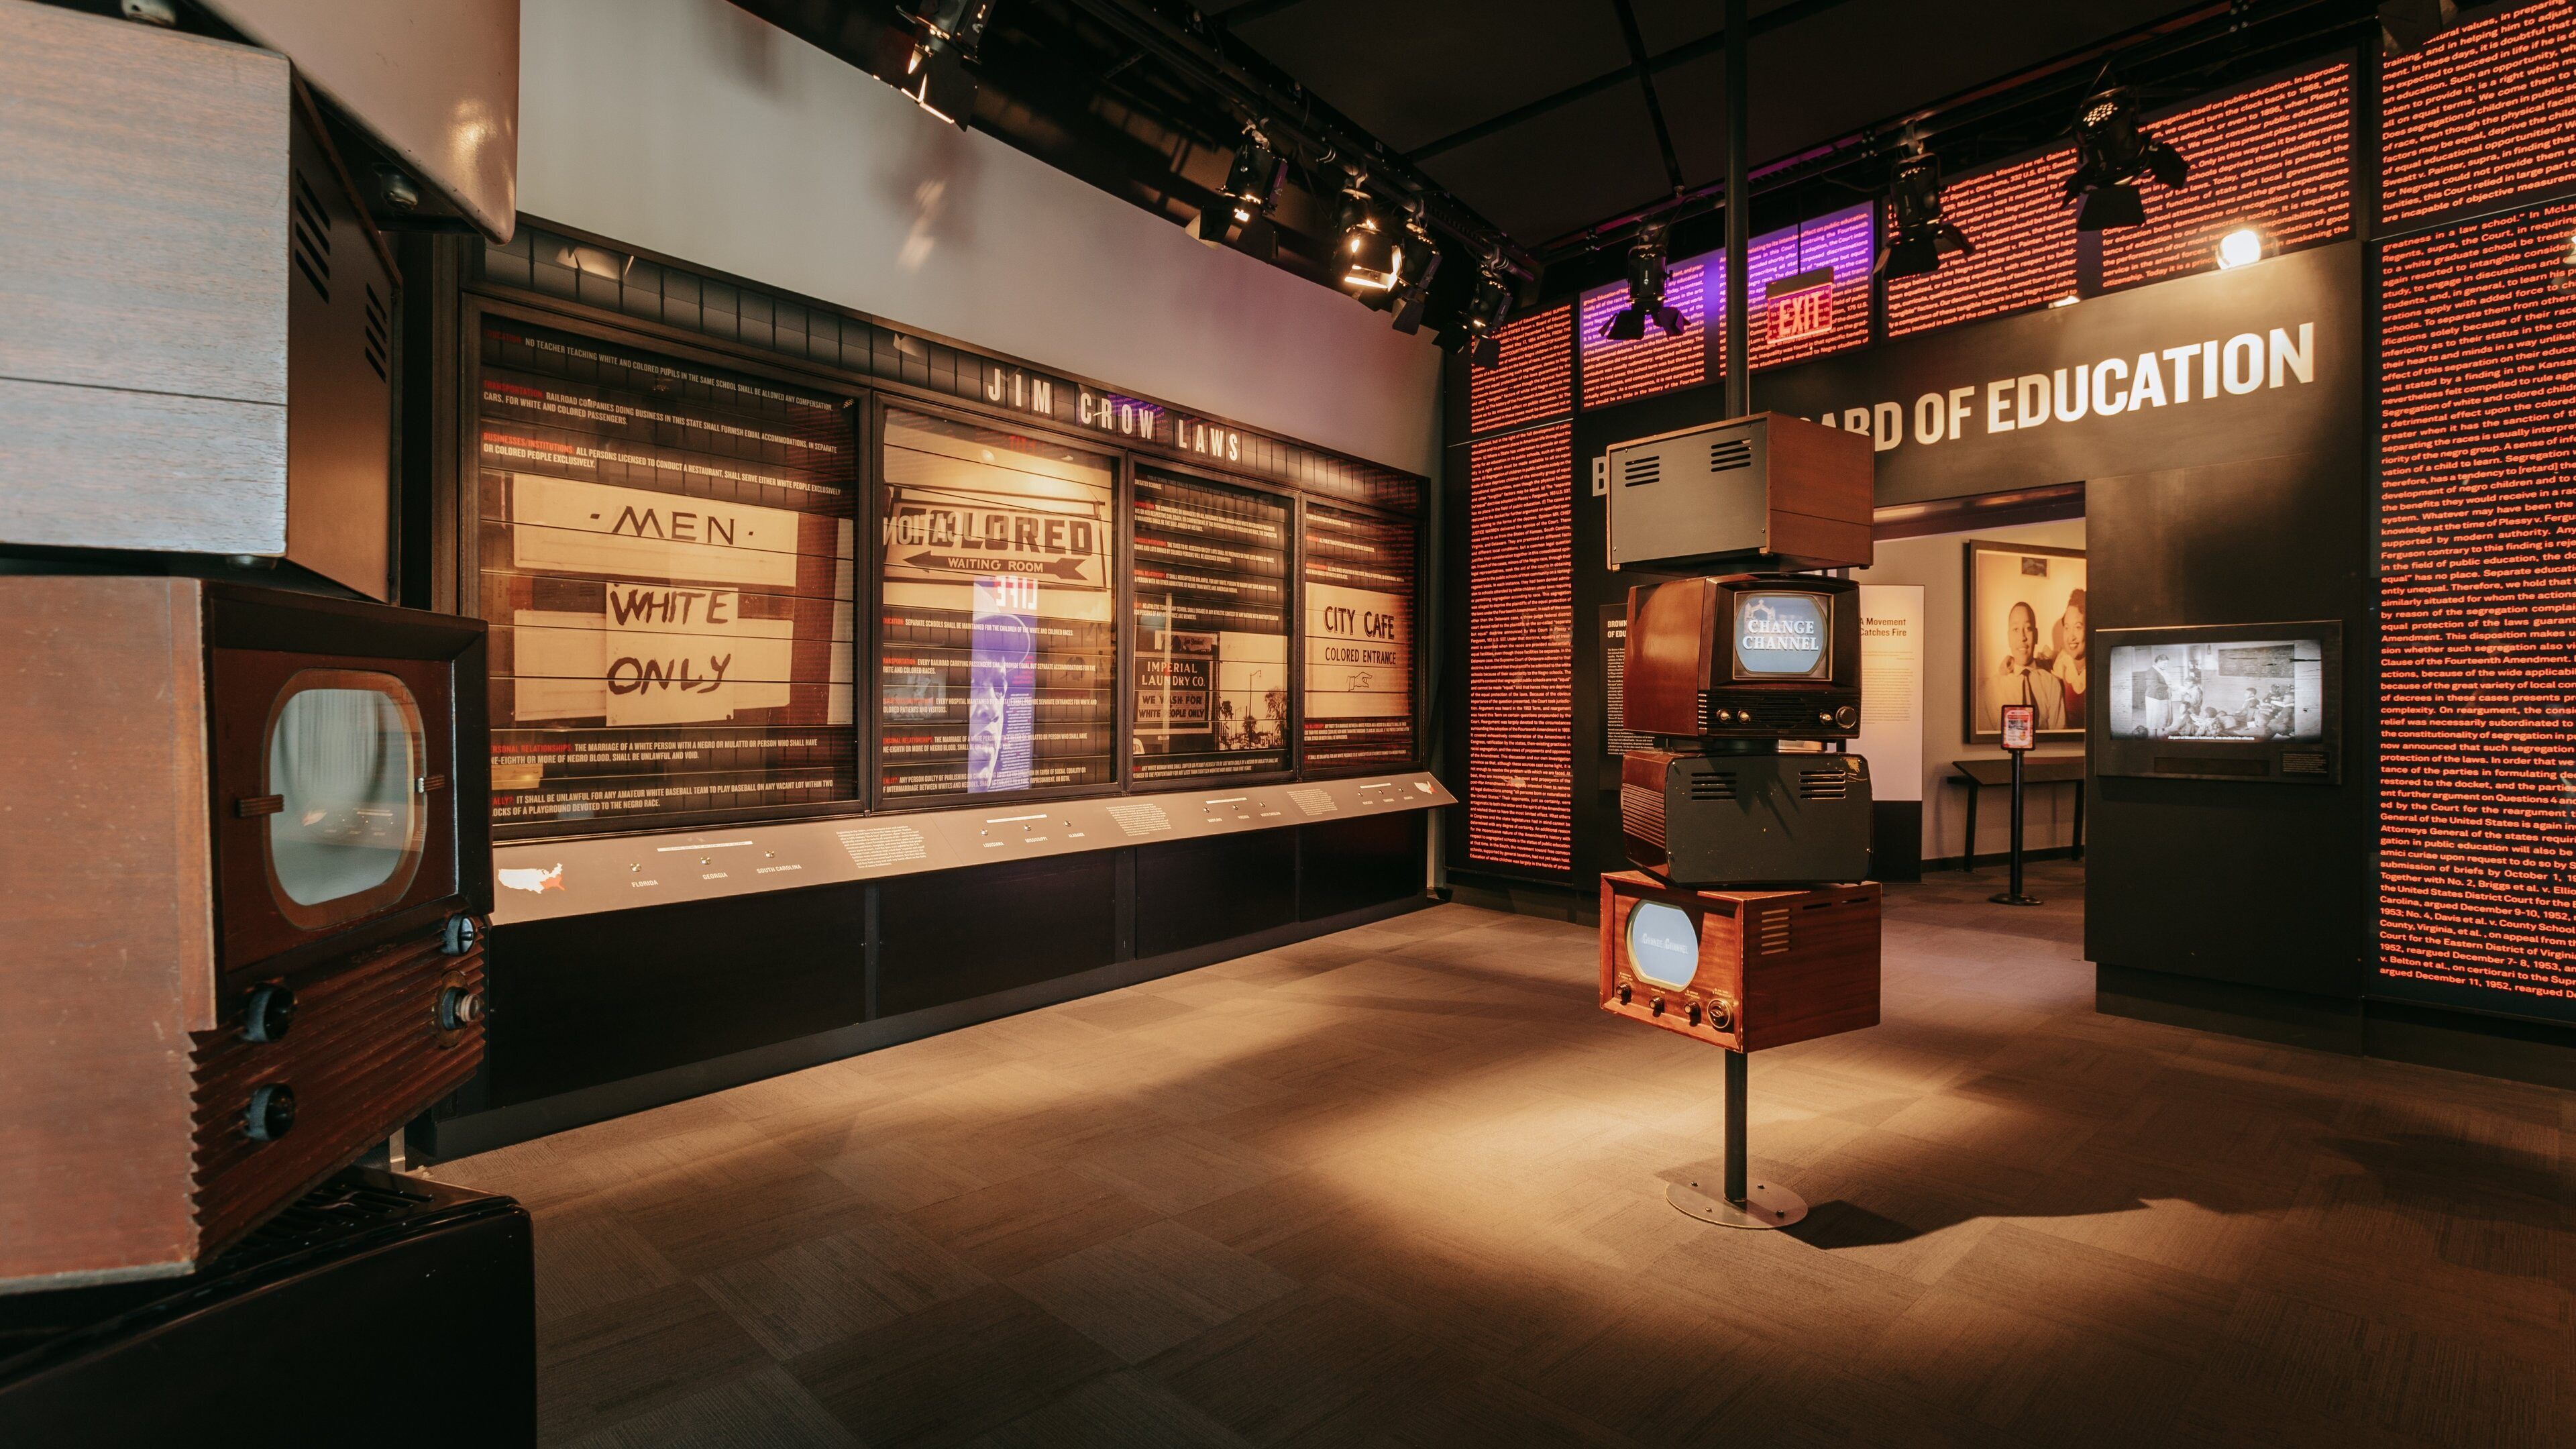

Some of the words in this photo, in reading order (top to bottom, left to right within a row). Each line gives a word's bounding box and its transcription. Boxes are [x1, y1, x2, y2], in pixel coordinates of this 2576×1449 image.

[2383, 52, 2422, 69] training,
[2426, 43, 2445, 56] and
[2447, 40, 2457, 50] in
[2460, 30, 2498, 47] helping
[2501, 21, 2520, 34] him
[2524, 17, 2534, 28] to
[2538, 6, 2573, 24] adjust
[2102, 235, 2113, 246] for
[2114, 228, 2151, 243] education
[2153, 221, 2171, 233] both
[2173, 210, 2223, 228] demonstrate
[2225, 206, 2239, 215] our
[2241, 195, 2288, 212] recognition
[2290, 189, 2300, 199] of
[2302, 185, 2317, 197] the
[2319, 180, 2348, 193] impor-
[1780, 291, 1825, 336] EXIT
[1915, 386, 1975, 445] OF
[1988, 322, 2314, 433] EDUCATION
[484, 392, 504, 402] CARS,
[505, 395, 518, 405] FOR
[520, 398, 541, 409] WHITE
[543, 402, 555, 411] AND
[557, 405, 586, 417] COLORED
[587, 411, 628, 424] PASSENGERS.
[546, 392, 577, 405] RAILROAD
[578, 397, 614, 411] COMPANIES
[615, 405, 633, 415] DOING
[635, 409, 663, 421] BUSINESS
[672, 415, 684, 425] THIS
[686, 418, 702, 428] STATE
[703, 421, 719, 431] SHALL
[720, 425, 743, 435] FURNISH
[745, 429, 759, 439] EQUAL
[761, 433, 807, 447] ACCOMMODATIONS,
[988, 368, 1051, 415] JIM
[1081, 392, 1154, 439] CROW
[1179, 419, 1238, 462] LAWS
[2391, 413, 2447, 428] detrimental
[2451, 409, 2481, 421] effect
[2485, 407, 2510, 418] upon
[2514, 402, 2531, 413] the
[2534, 396, 2575, 410] colored
[483, 443, 493, 453] OR
[494, 445, 526, 458] COLORED
[527, 449, 551, 462] PEOPLE
[553, 454, 596, 468] EXCLUSIVELY.
[576, 446, 587, 456] ALL
[588, 449, 616, 461] PERSONS
[618, 453, 646, 465] LICENSED
[647, 458, 655, 466] TO
[656, 460, 682, 471] CONDUCT
[684, 464, 687, 472] A
[688, 464, 723, 477] RESTAURANT,
[724, 470, 741, 480] SHALL
[741, 473, 757, 482] SERVE
[758, 476, 775, 485] EITHER
[776, 478, 792, 488] WHITE
[792, 481, 810, 491] PEOPLE
[811, 484, 840, 495] EXCLUSIVELY
[2381, 515, 2418, 525] system.
[2422, 508, 2469, 521] Whatever
[2472, 508, 2493, 518] may
[2497, 504, 2521, 514] have
[2524, 501, 2551, 512] been
[2555, 499, 2573, 509] the
[612, 506, 735, 545] MEN
[899, 507, 1093, 556] COLORED
[947, 557, 1002, 570] WAITING
[1008, 560, 1044, 573] ROOM
[610, 588, 729, 626] WHITE
[1324, 606, 1356, 635] CITY
[1363, 611, 1395, 640] CAFE
[1748, 620, 1814, 635] CHANGE
[1860, 628, 1890, 636] Catches
[1325, 647, 1359, 662] COLORED
[1363, 650, 1396, 665] ENTRANCE
[1742, 636, 1819, 651] CHANNEL
[607, 653, 731, 696] ONLY
[1147, 661, 1197, 673] IMPERIAL
[1192, 676, 1205, 686] CO.
[1142, 696, 1155, 704] WE
[1186, 696, 1201, 704] FOR
[1139, 709, 1161, 718] WHITE
[1188, 709, 1204, 718] ONLY
[2380, 717, 2405, 726] relief
[2429, 718, 2485, 729] necessarily
[2488, 718, 2559, 727] subordinated
[2562, 719, 2573, 727] to
[526, 755, 536, 764] OR
[537, 755, 555, 764] MORE
[567, 754, 588, 762] NEGRO
[589, 753, 610, 761] BLOOD,
[612, 753, 631, 761] SHALL
[641, 752, 670, 760] UNLAWFUL
[684, 751, 698, 759] VOID.
[2380, 836, 2410, 848] gation
[2412, 838, 2421, 847] in
[2424, 839, 2454, 851] public
[2457, 842, 2508, 853] education
[2512, 845, 2530, 854] will
[2533, 847, 2556, 855] also
[2559, 848, 2573, 857] be
[702, 872, 728, 880] GEORGIA
[775, 863, 802, 872] CAROLINA
[631, 879, 658, 888] FLORIDA
[2380, 966, 2412, 979] argued
[2415, 970, 2465, 984] December
[2469, 977, 2481, 987] 11,
[2485, 979, 2511, 991] 1952,
[2515, 984, 2563, 998] reargued
